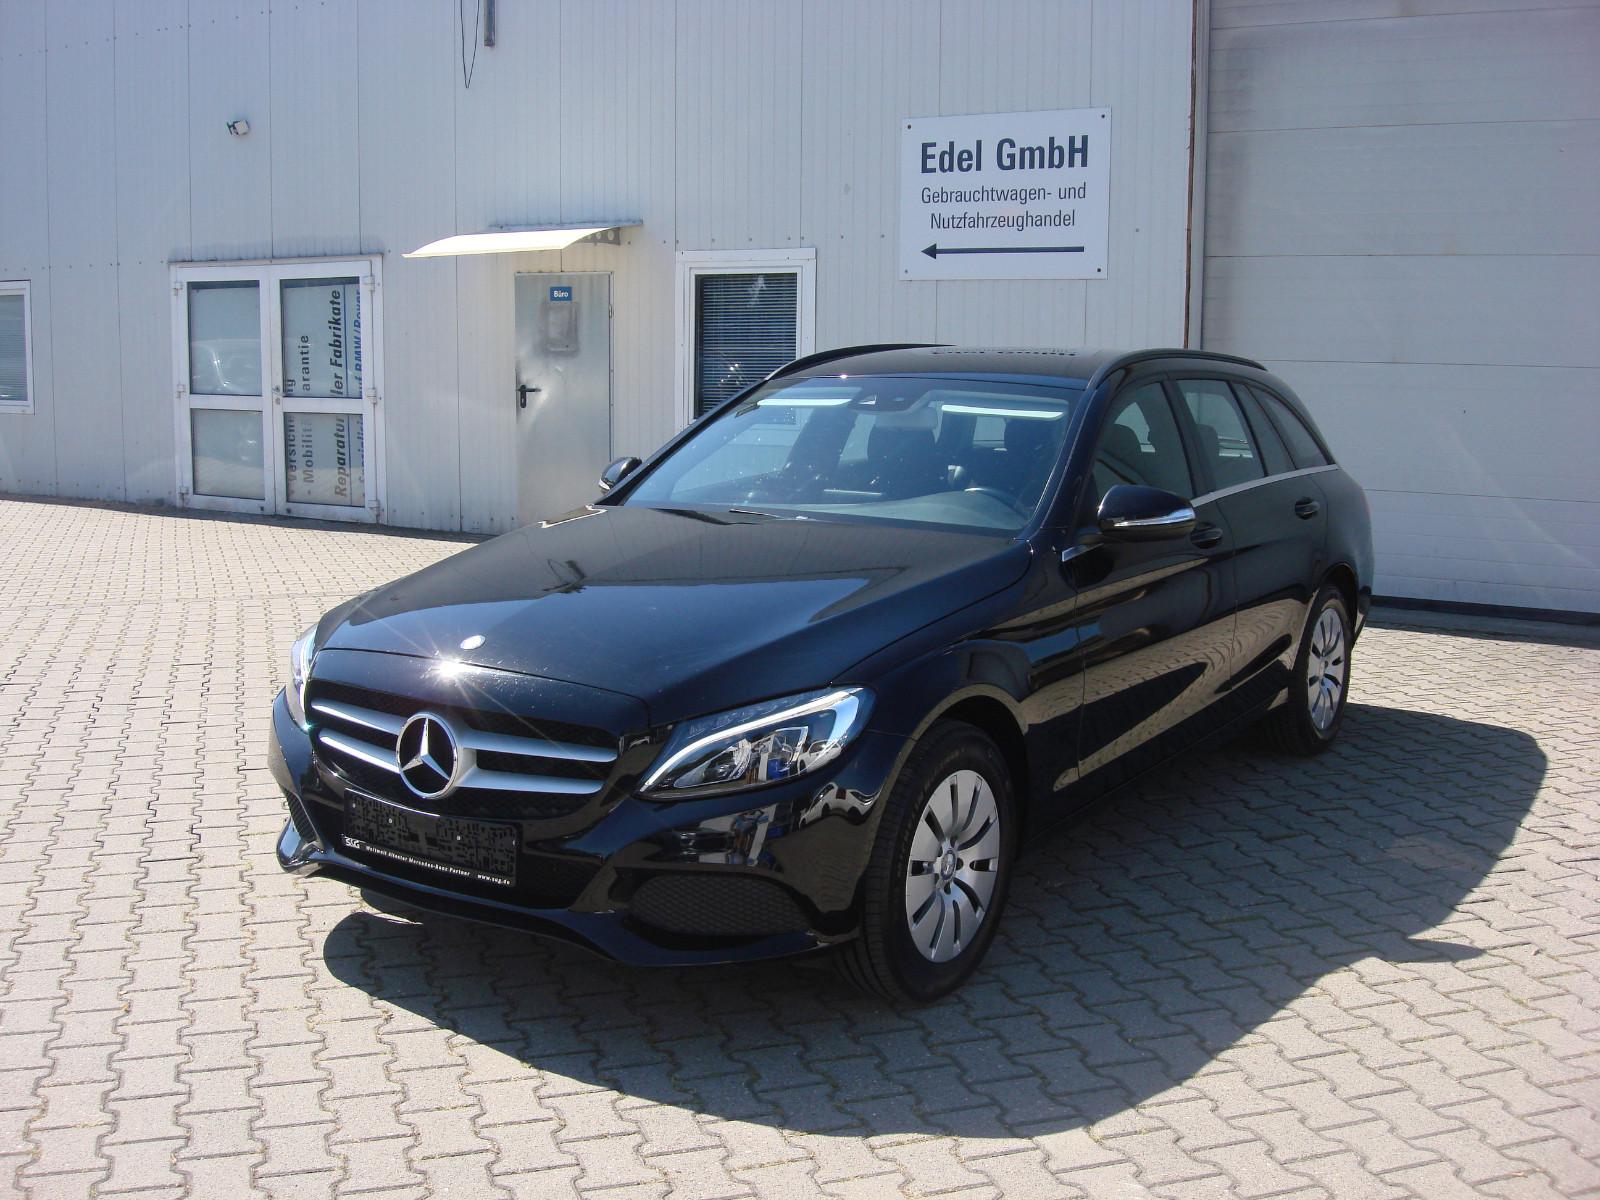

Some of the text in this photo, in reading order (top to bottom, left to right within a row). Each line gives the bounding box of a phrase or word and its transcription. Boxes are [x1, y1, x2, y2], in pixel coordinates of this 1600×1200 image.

[921, 134, 1089, 174] Edel GmbH
[921, 182, 1086, 205] Gebrauchtwagen- und
[930, 209, 1075, 231] Nutzfahrzeughandel
[328, 290, 343, 368] Fabrikate
